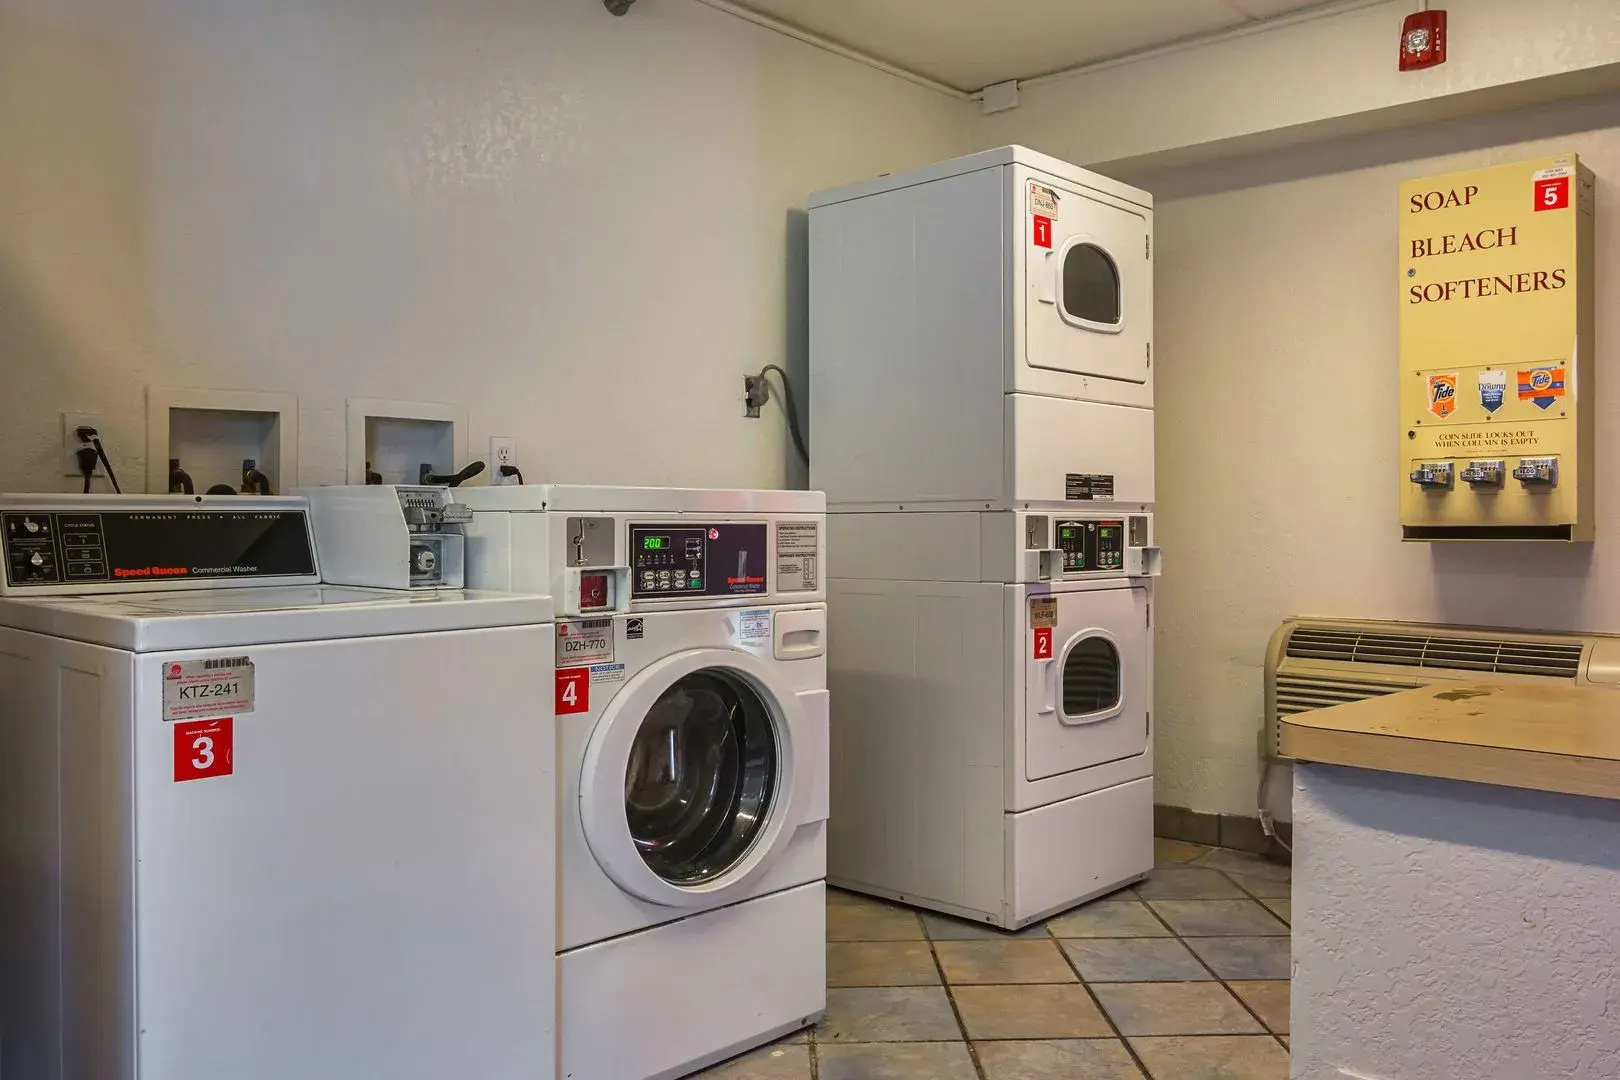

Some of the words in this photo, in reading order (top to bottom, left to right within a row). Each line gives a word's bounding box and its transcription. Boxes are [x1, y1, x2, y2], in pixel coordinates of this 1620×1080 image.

[1410, 185, 1479, 214] SOAP
[1543, 186, 1558, 206] 5
[1039, 224, 1045, 243] 1
[1411, 226, 1519, 259] BLEACH
[1410, 268, 1567, 305] SOFTENERS
[1532, 374, 1550, 387] Tide
[1433, 383, 1455, 403] Tide
[1434, 440, 1460, 448] WHEN
[1461, 439, 1498, 448] COLUMN
[1500, 438, 1508, 446] IS
[1510, 437, 1540, 445] EMPTY
[1439, 433, 1460, 441] COIN
[1461, 432, 1483, 440] SLIDE
[1485, 431, 1514, 439] LOCKS
[1516, 430, 1535, 438] OUT
[644, 538, 661, 548] 200
[114, 567, 151, 578] Speed
[151, 566, 188, 575] Queen
[192, 566, 232, 574] Commercial
[232, 565, 258, 573] Washer
[565, 639, 606, 652] DZH-770
[1039, 636, 1047, 653] 2
[179, 682, 238, 699] KTZ-241
[562, 680, 578, 707] 4
[191, 736, 215, 769] 3
